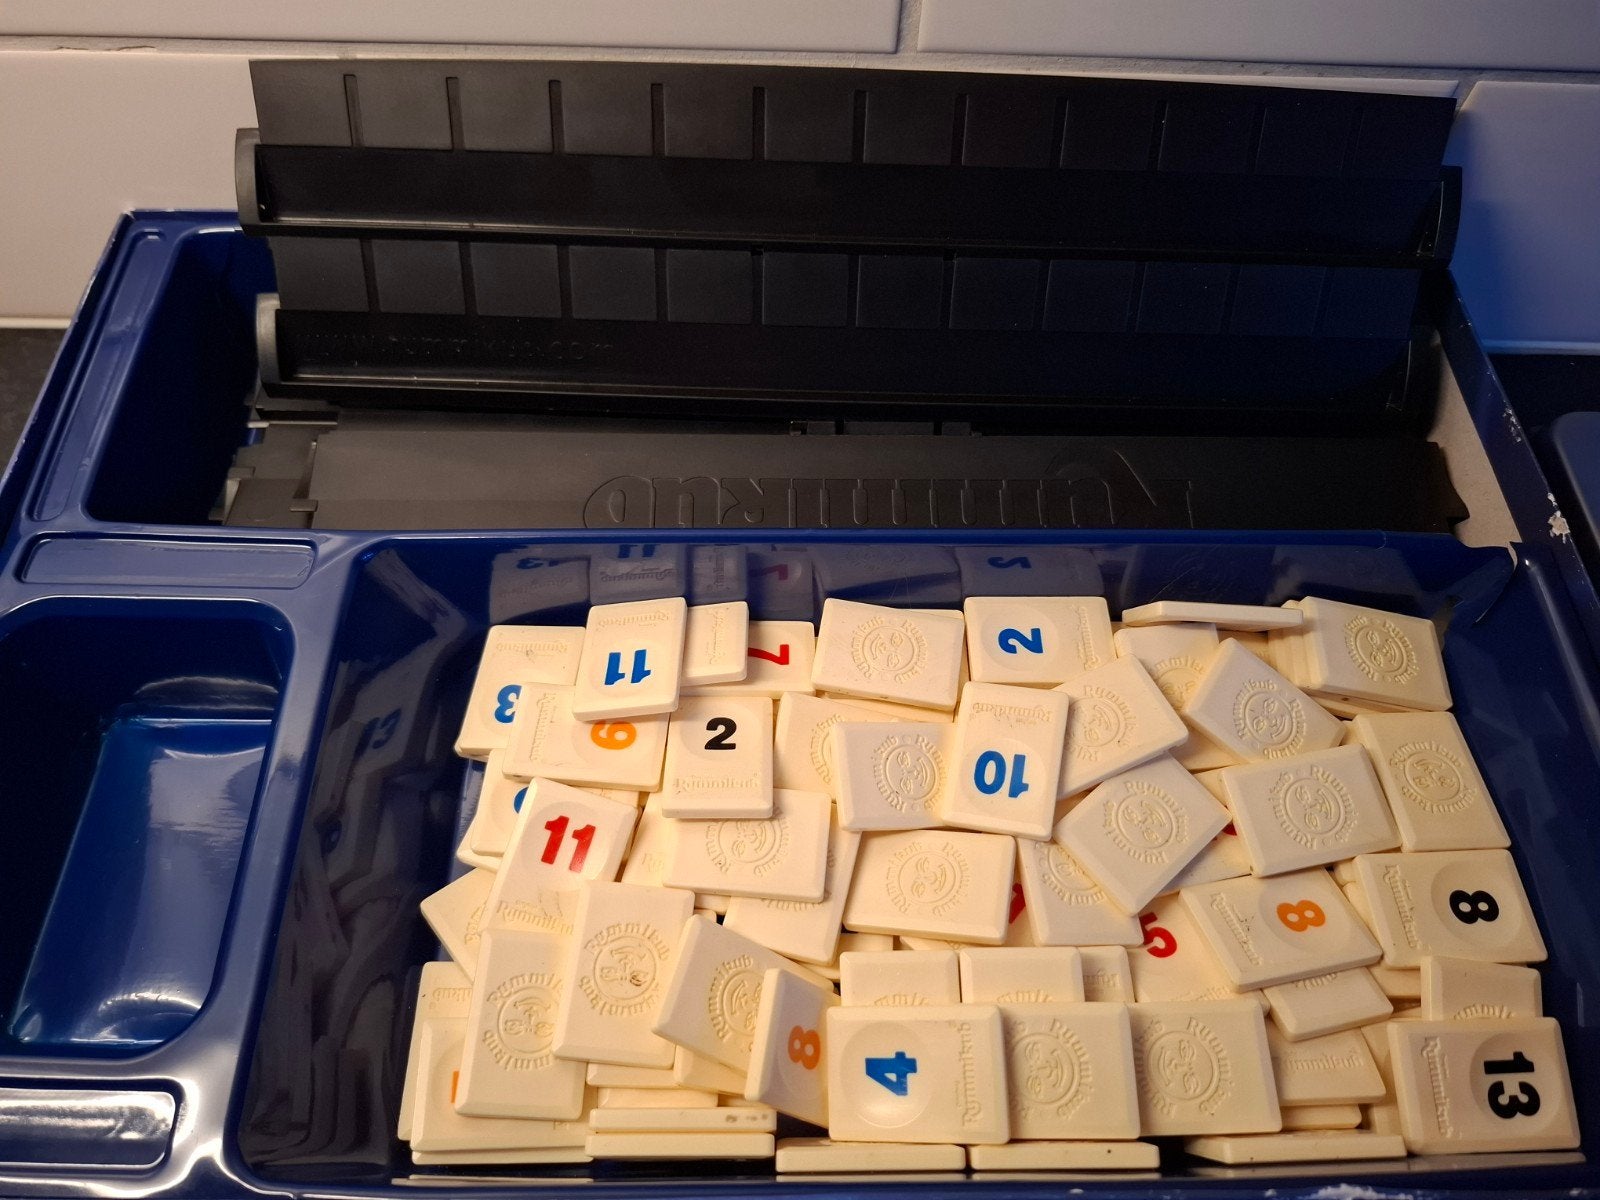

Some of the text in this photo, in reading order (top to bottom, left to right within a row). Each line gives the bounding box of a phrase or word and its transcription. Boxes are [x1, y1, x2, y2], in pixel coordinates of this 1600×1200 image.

[747, 644, 790, 666] 7
[998, 627, 1044, 654] 2
[604, 649, 652, 686] 11
[704, 717, 737, 751] 2
[974, 750, 1030, 798] 10
[541, 815, 596, 873] 11
[1276, 899, 1327, 933] 8
[1448, 889, 1500, 925] 8
[1139, 911, 1178, 959] 5
[787, 1025, 821, 1071] 8
[865, 1051, 918, 1096] 4
[957, 1022, 983, 1128] Rummikub
[1483, 1051, 1541, 1120] 13
